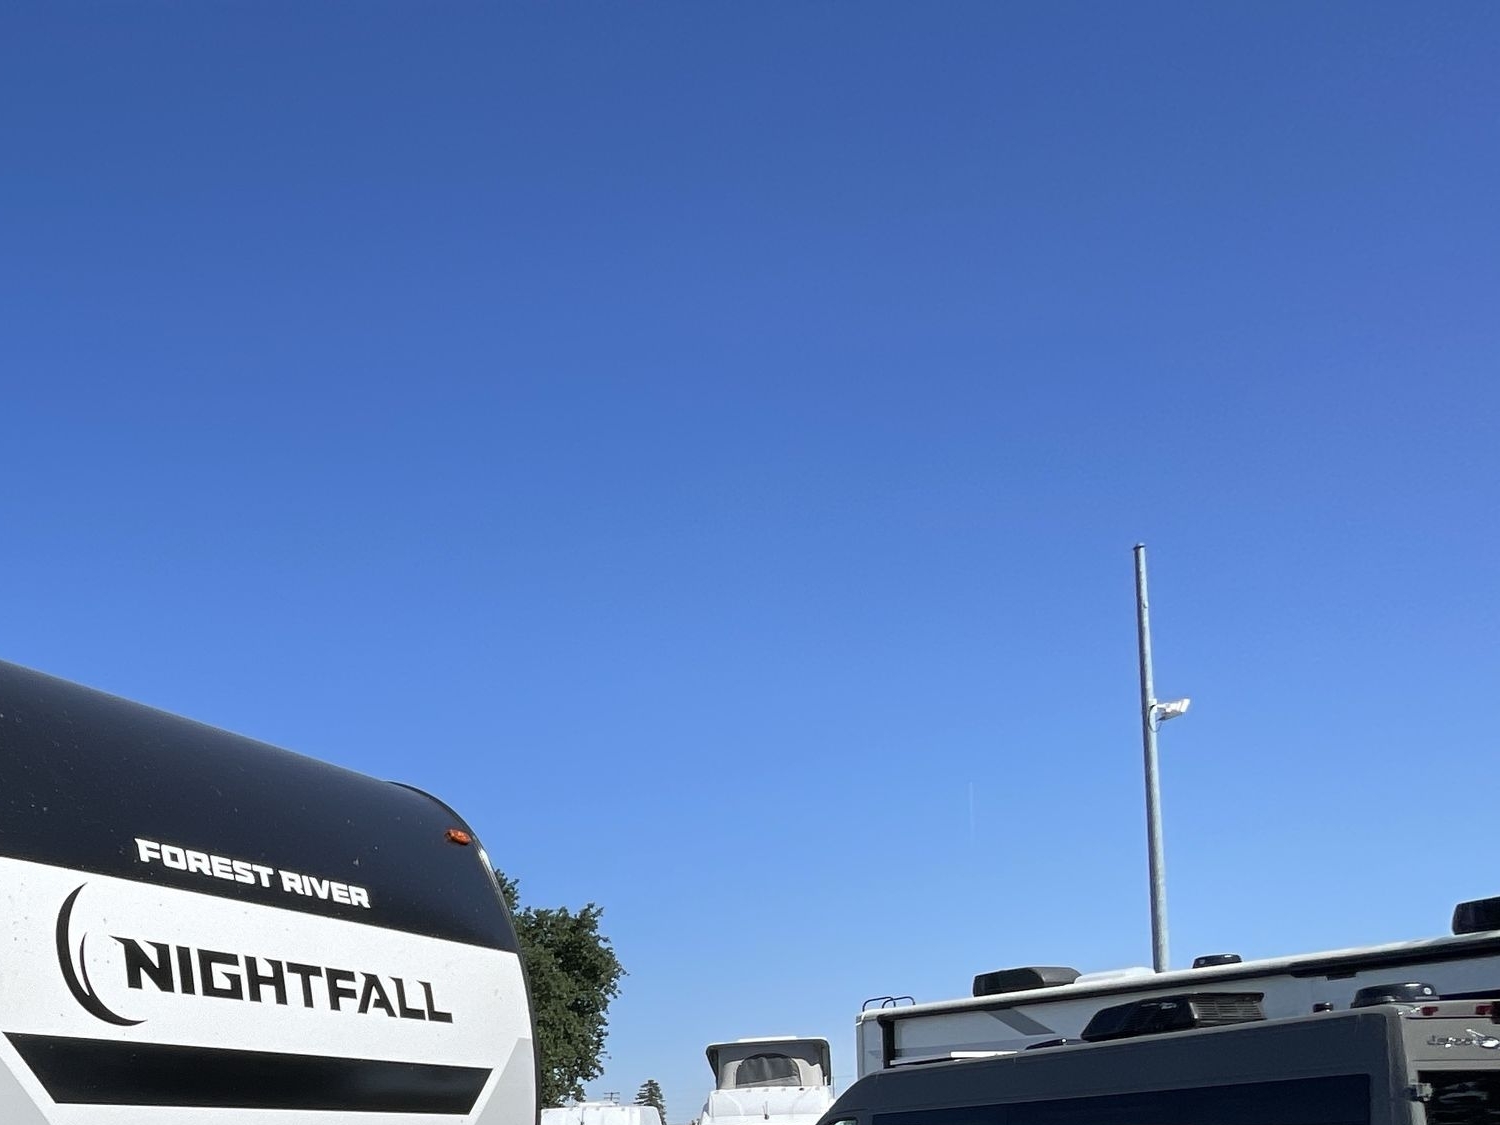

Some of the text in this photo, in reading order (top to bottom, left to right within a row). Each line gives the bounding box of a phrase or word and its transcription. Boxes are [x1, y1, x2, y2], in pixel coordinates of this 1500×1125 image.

[134, 838, 371, 909] FOREST RIVER
[108, 935, 454, 1024] NIGHTFALL
